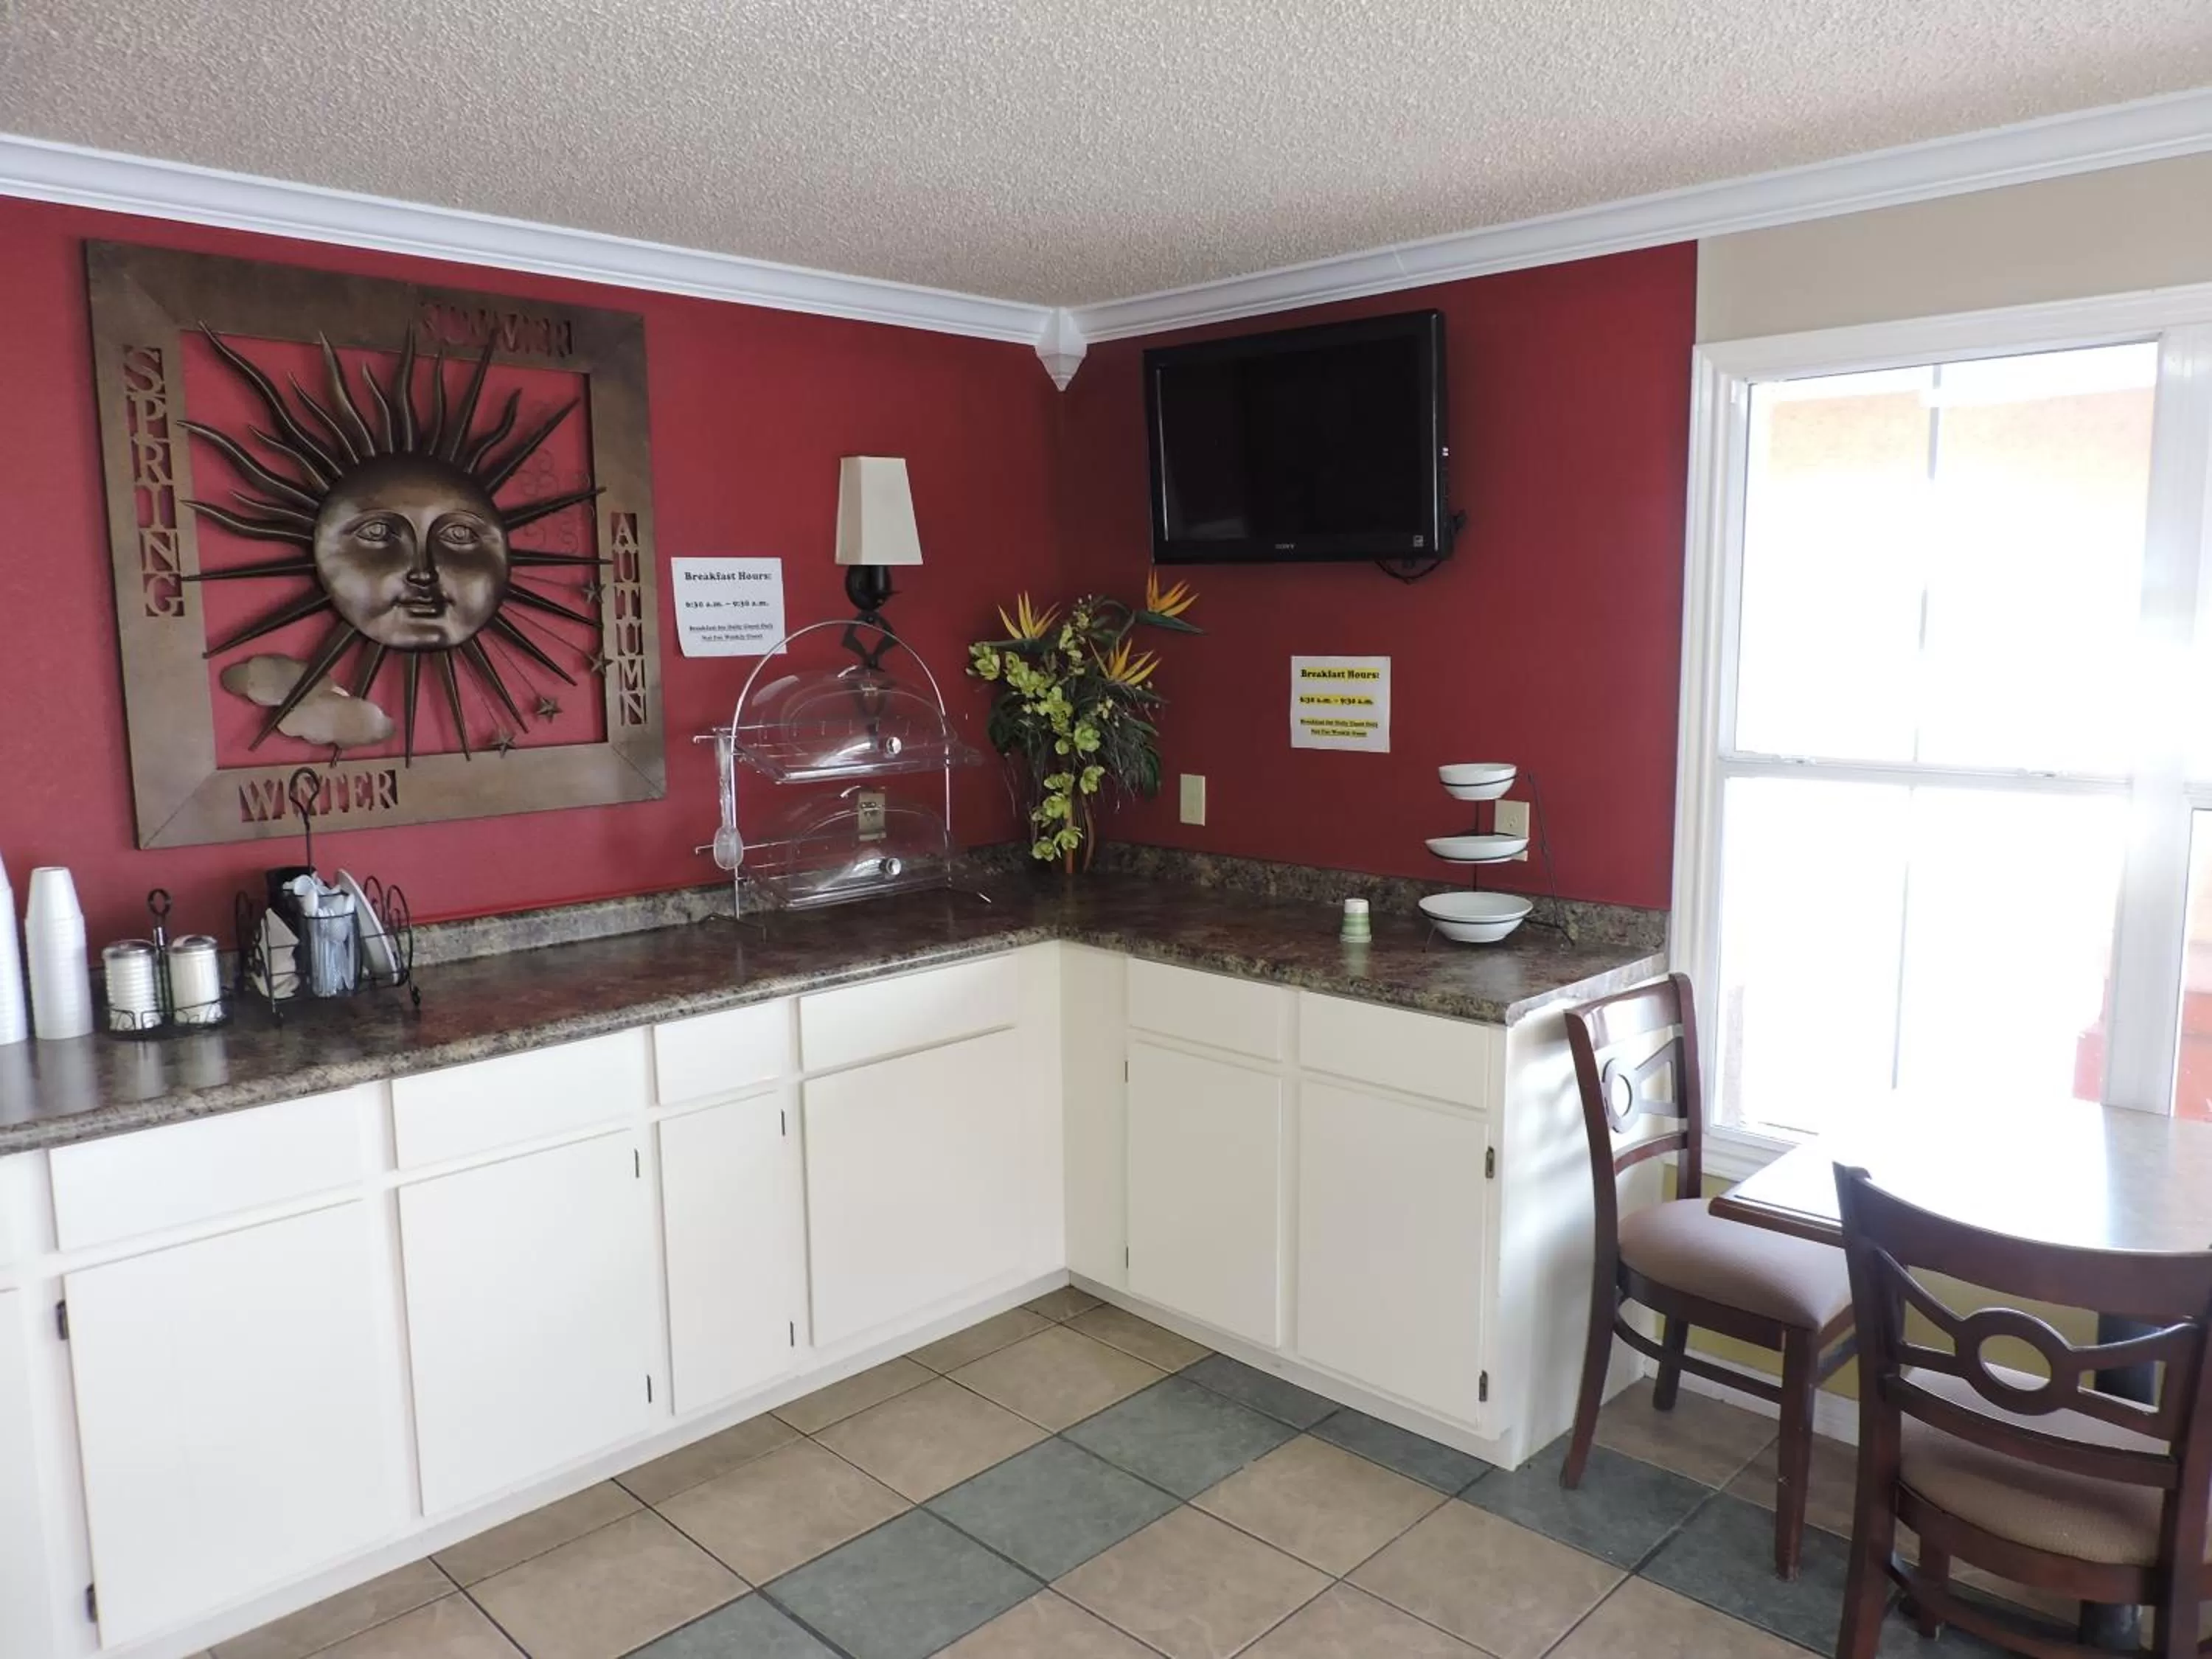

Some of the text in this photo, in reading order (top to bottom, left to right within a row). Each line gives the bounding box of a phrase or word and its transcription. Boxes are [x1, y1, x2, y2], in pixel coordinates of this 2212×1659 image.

[123, 345, 184, 617] SPRING
[684, 571, 772, 581] Breakfast Hours:
[611, 512, 647, 726] AUTUMN
[1301, 669, 1380, 679] Breakfast Hours:
[238, 769, 399, 824] WINTER
